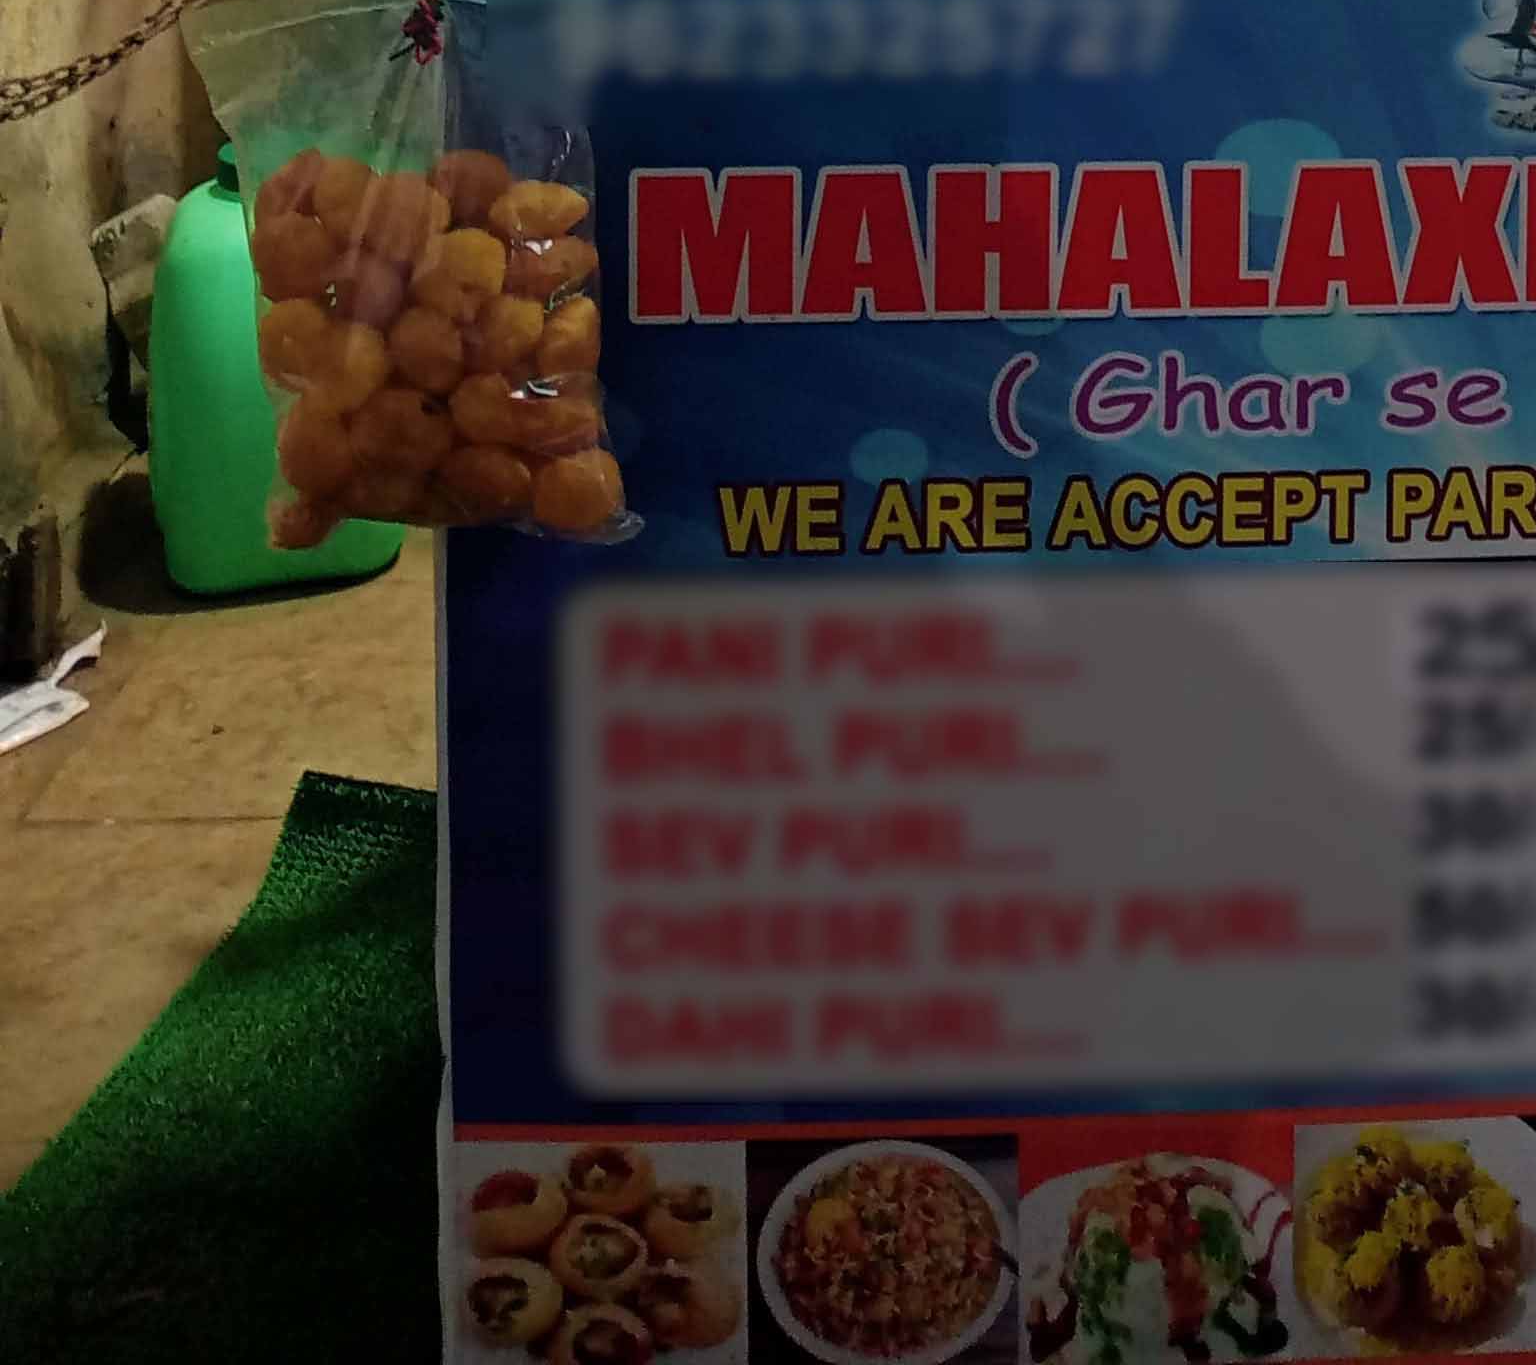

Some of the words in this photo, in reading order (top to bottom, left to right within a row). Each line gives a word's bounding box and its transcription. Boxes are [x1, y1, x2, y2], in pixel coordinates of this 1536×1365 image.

[1070, 351, 1348, 437] Ghar
[1382, 369, 1506, 429] se
[718, 487, 848, 555] WE
[864, 485, 1030, 551] ARE
[1050, 475, 1368, 547] ACCEPT
